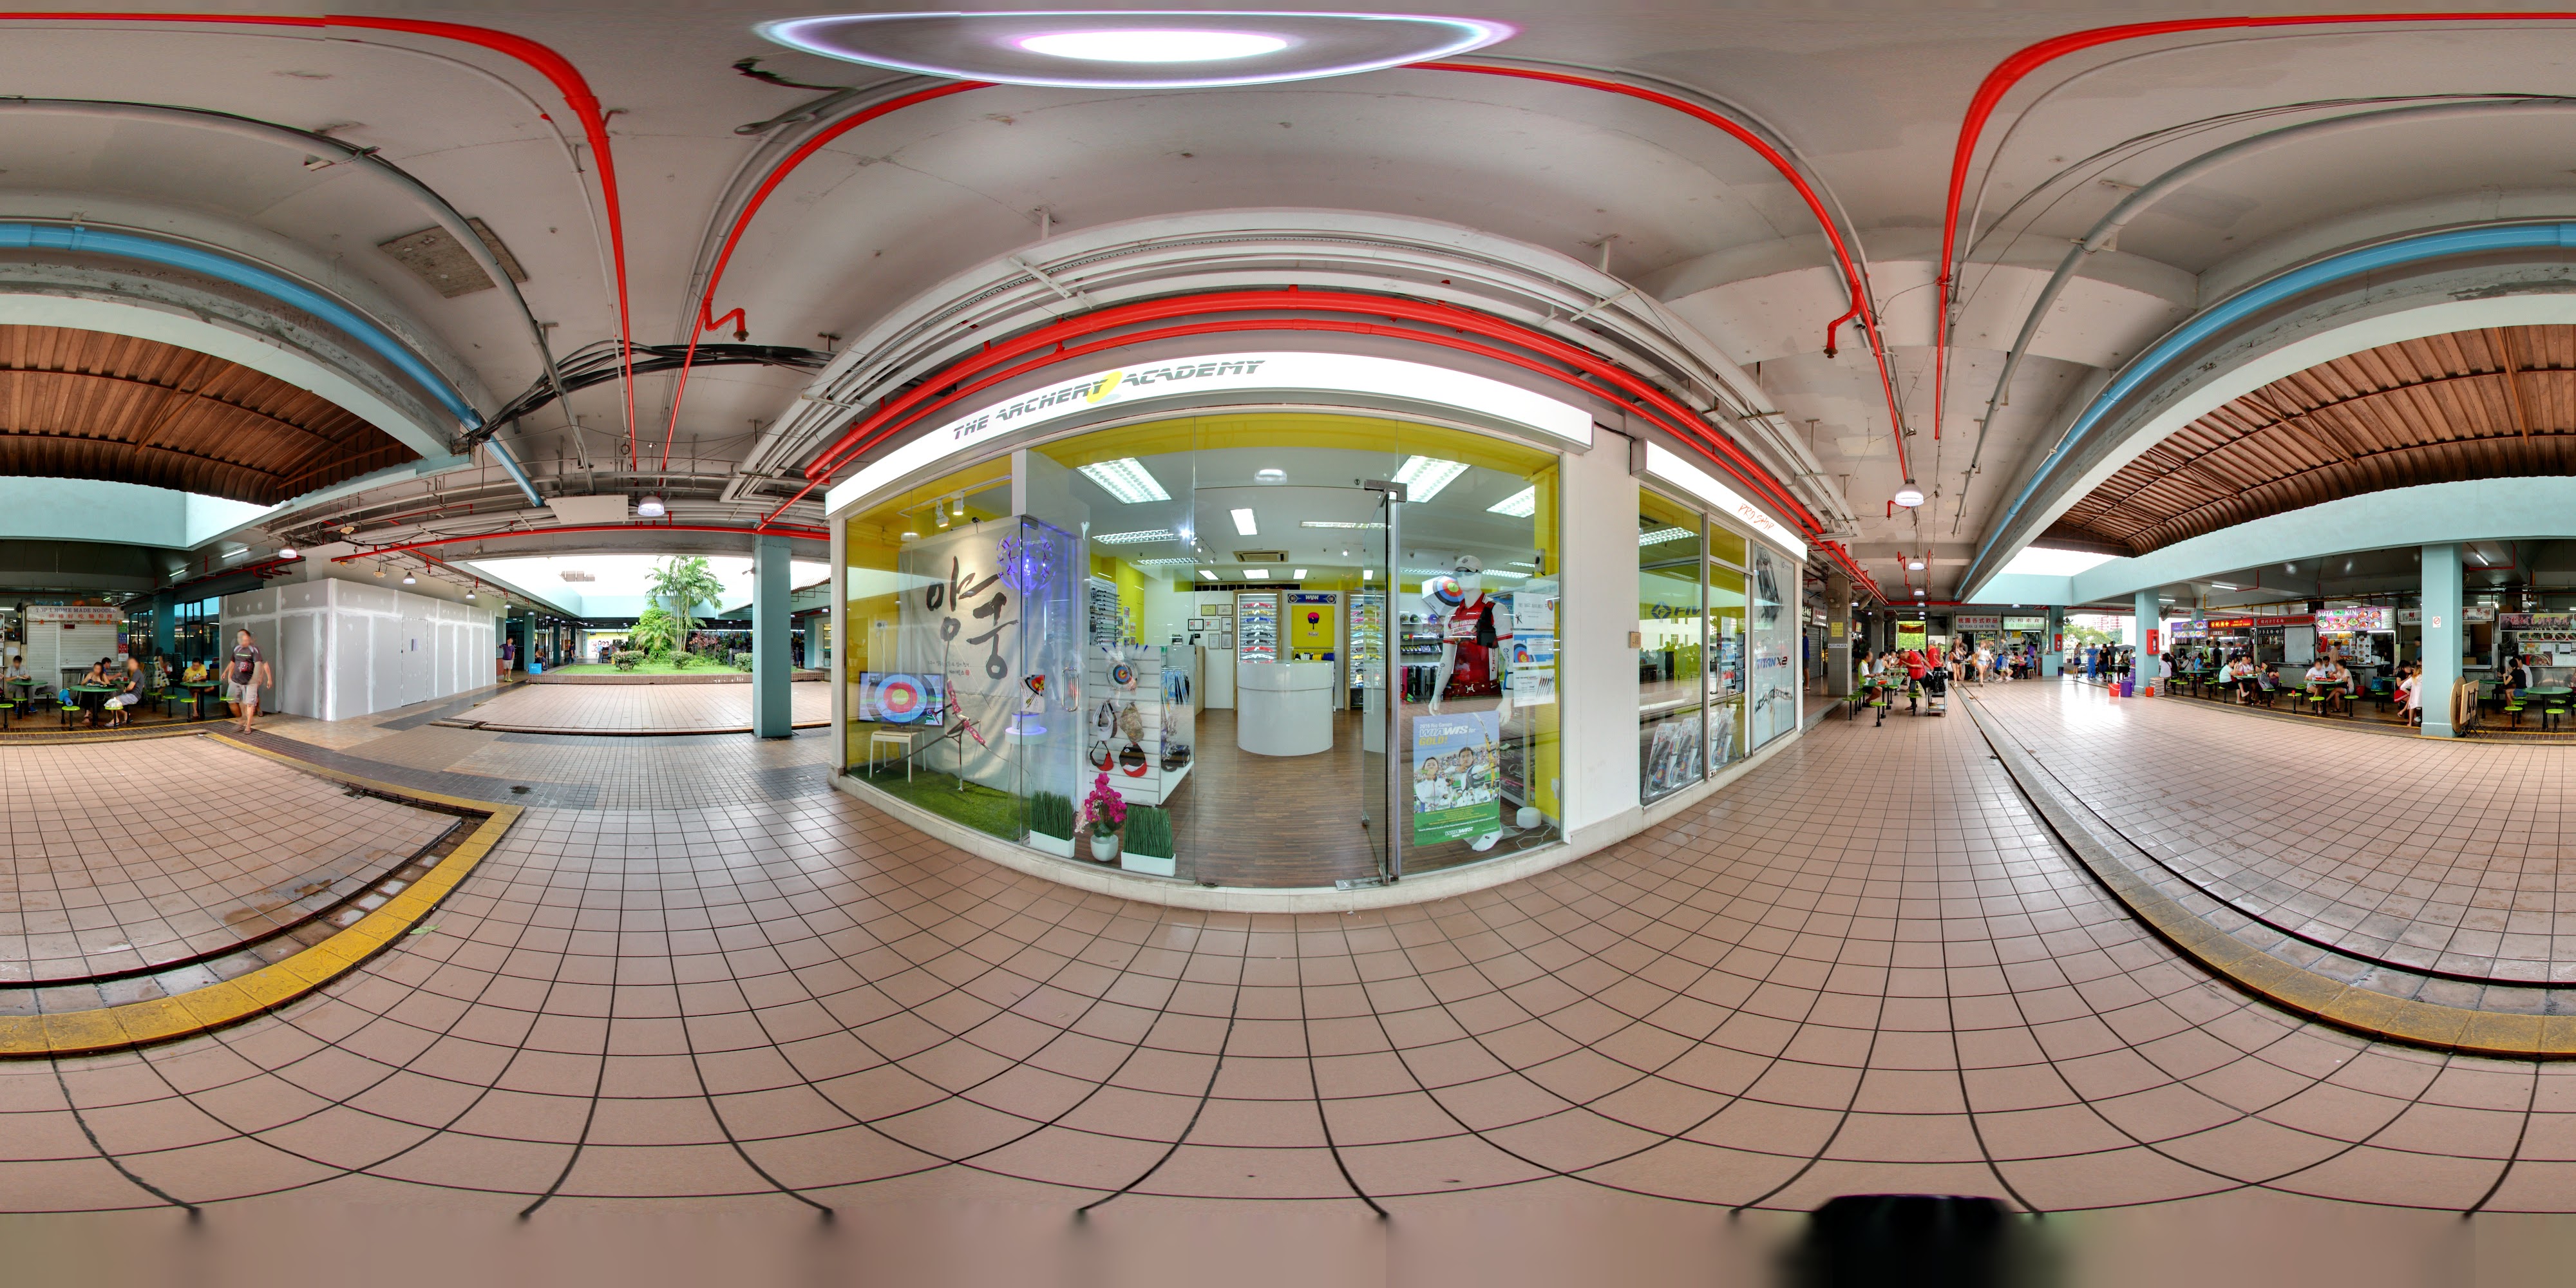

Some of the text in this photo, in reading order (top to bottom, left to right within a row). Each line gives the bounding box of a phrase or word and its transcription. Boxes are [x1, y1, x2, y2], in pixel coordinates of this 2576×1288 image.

[953, 360, 1266, 440] THE ARCHERY ACADEMY
[1738, 503, 1775, 531] PRO SHOP
[1419, 725, 1468, 737] WIAWIS
[1419, 735, 1448, 746] GOLD!
